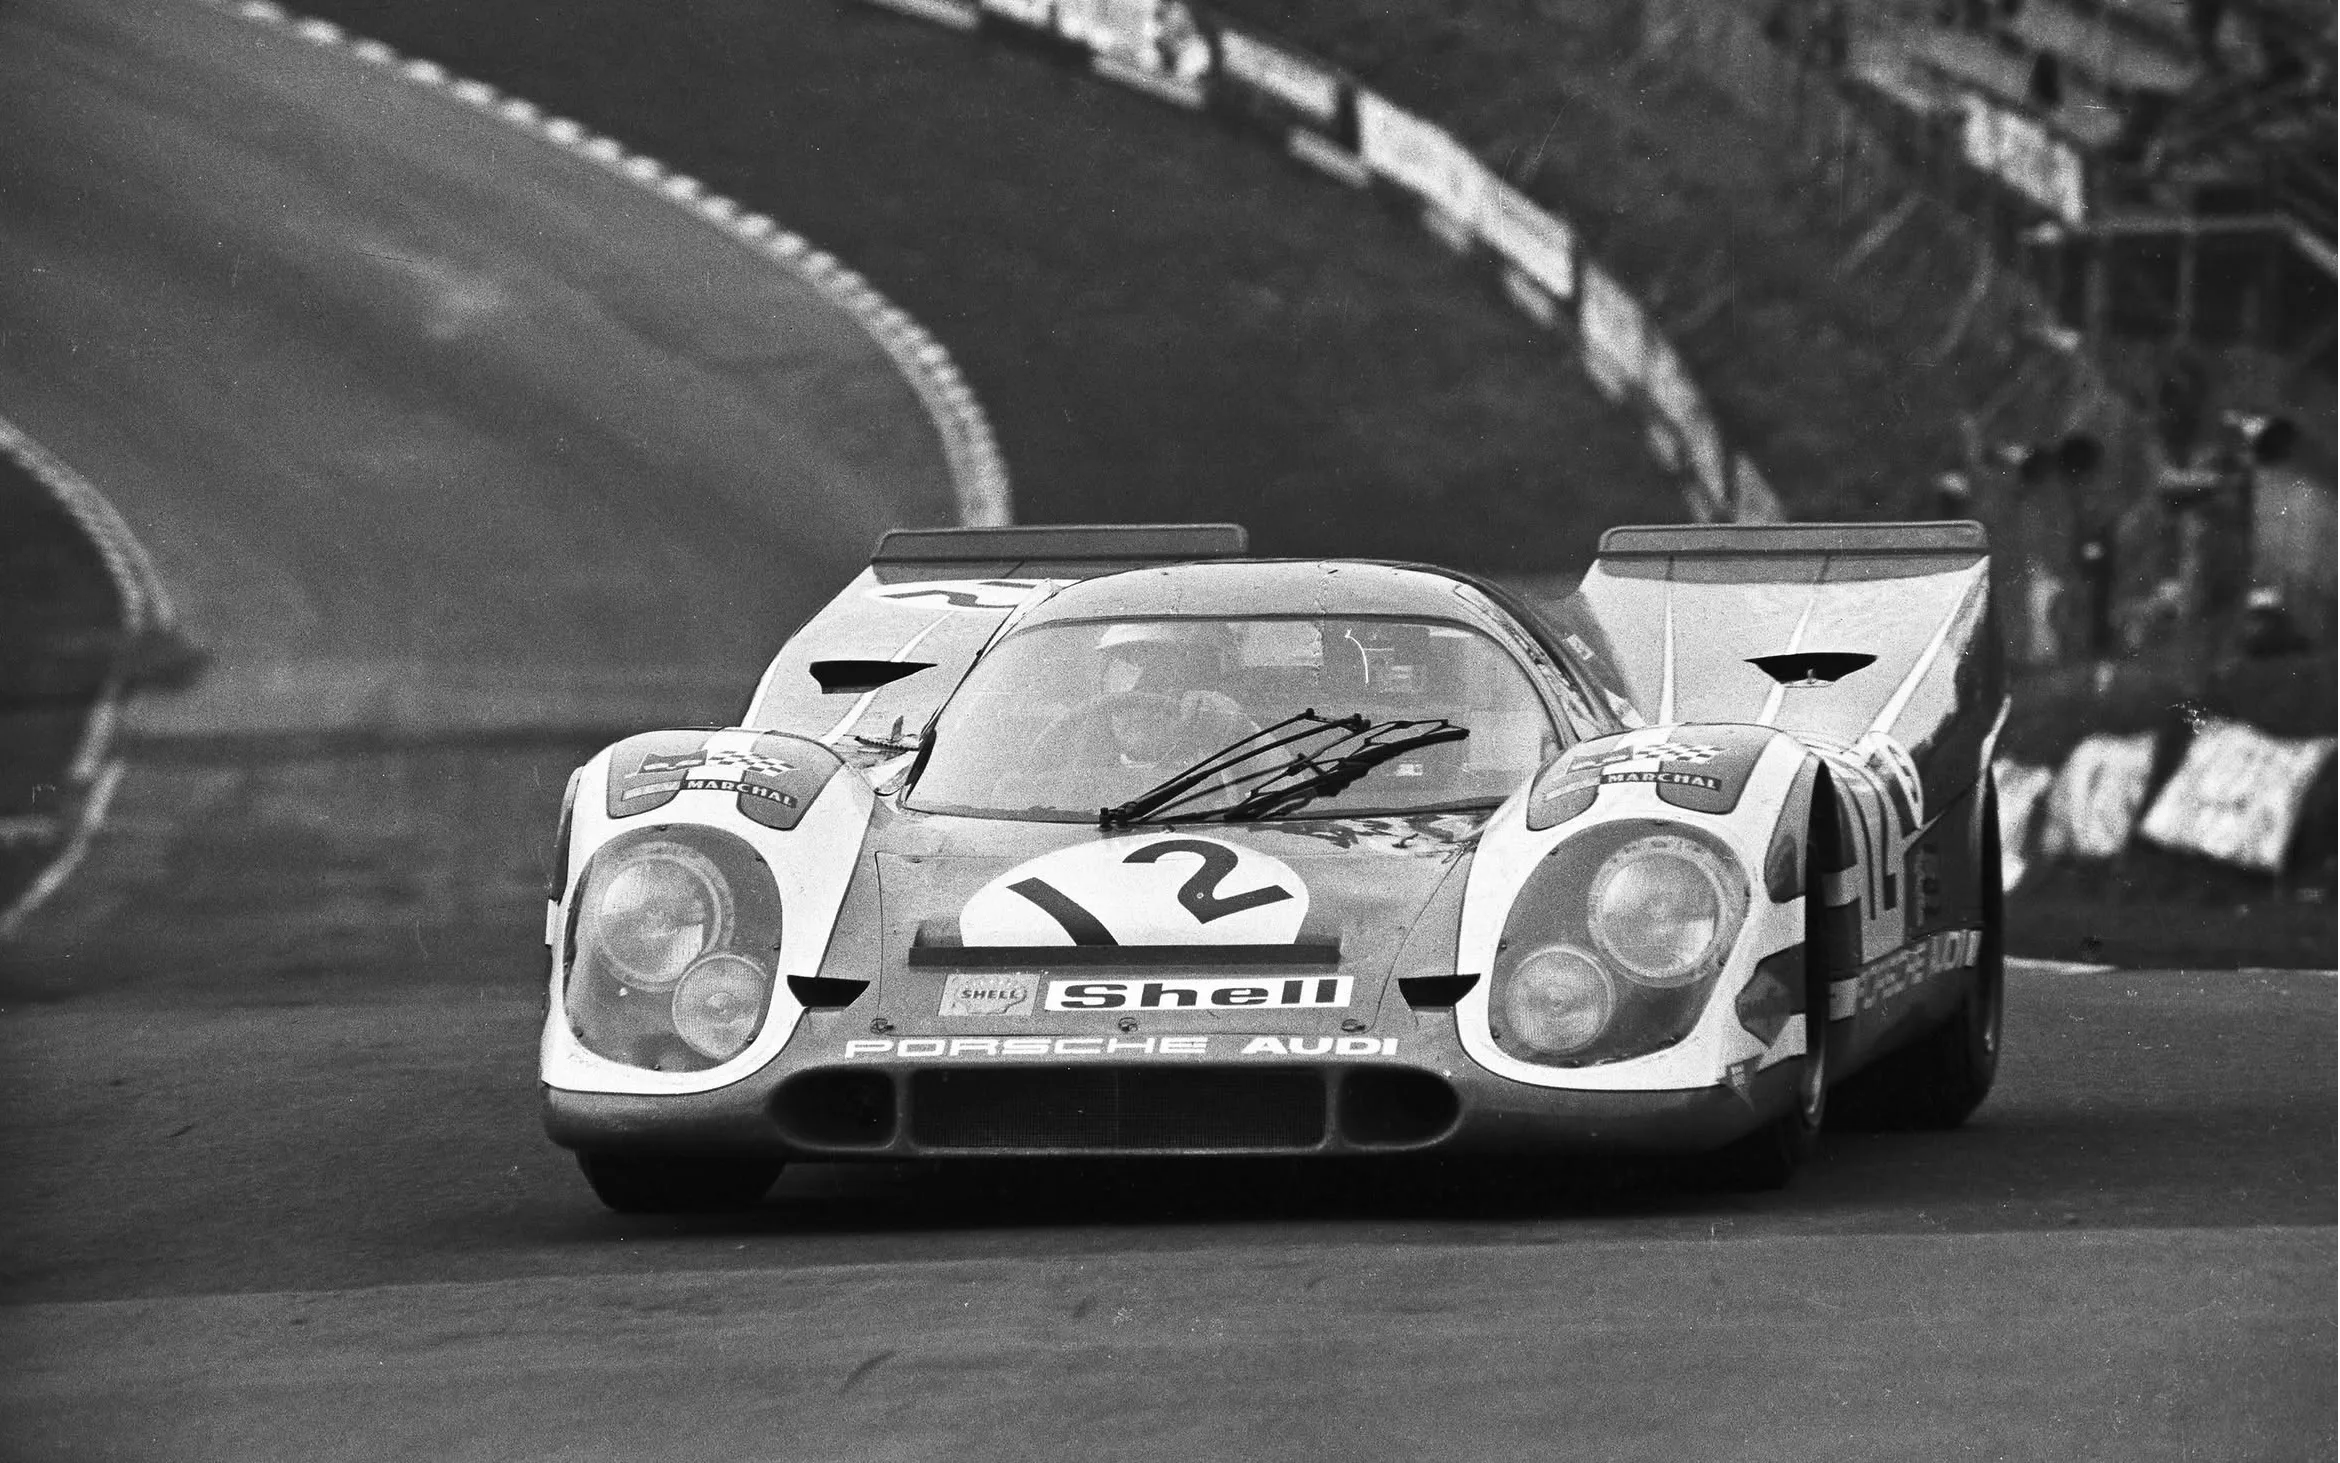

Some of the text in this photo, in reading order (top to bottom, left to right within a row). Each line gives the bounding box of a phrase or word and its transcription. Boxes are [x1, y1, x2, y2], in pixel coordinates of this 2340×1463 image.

[1608, 772, 1716, 789] MARCHAL
[687, 780, 791, 806] MARCHAL
[1004, 839, 1296, 947] 12
[960, 989, 1017, 1000] SHELL
[1061, 979, 1338, 1009] Shell
[844, 1037, 1399, 1060] PORSCHE AUDI
